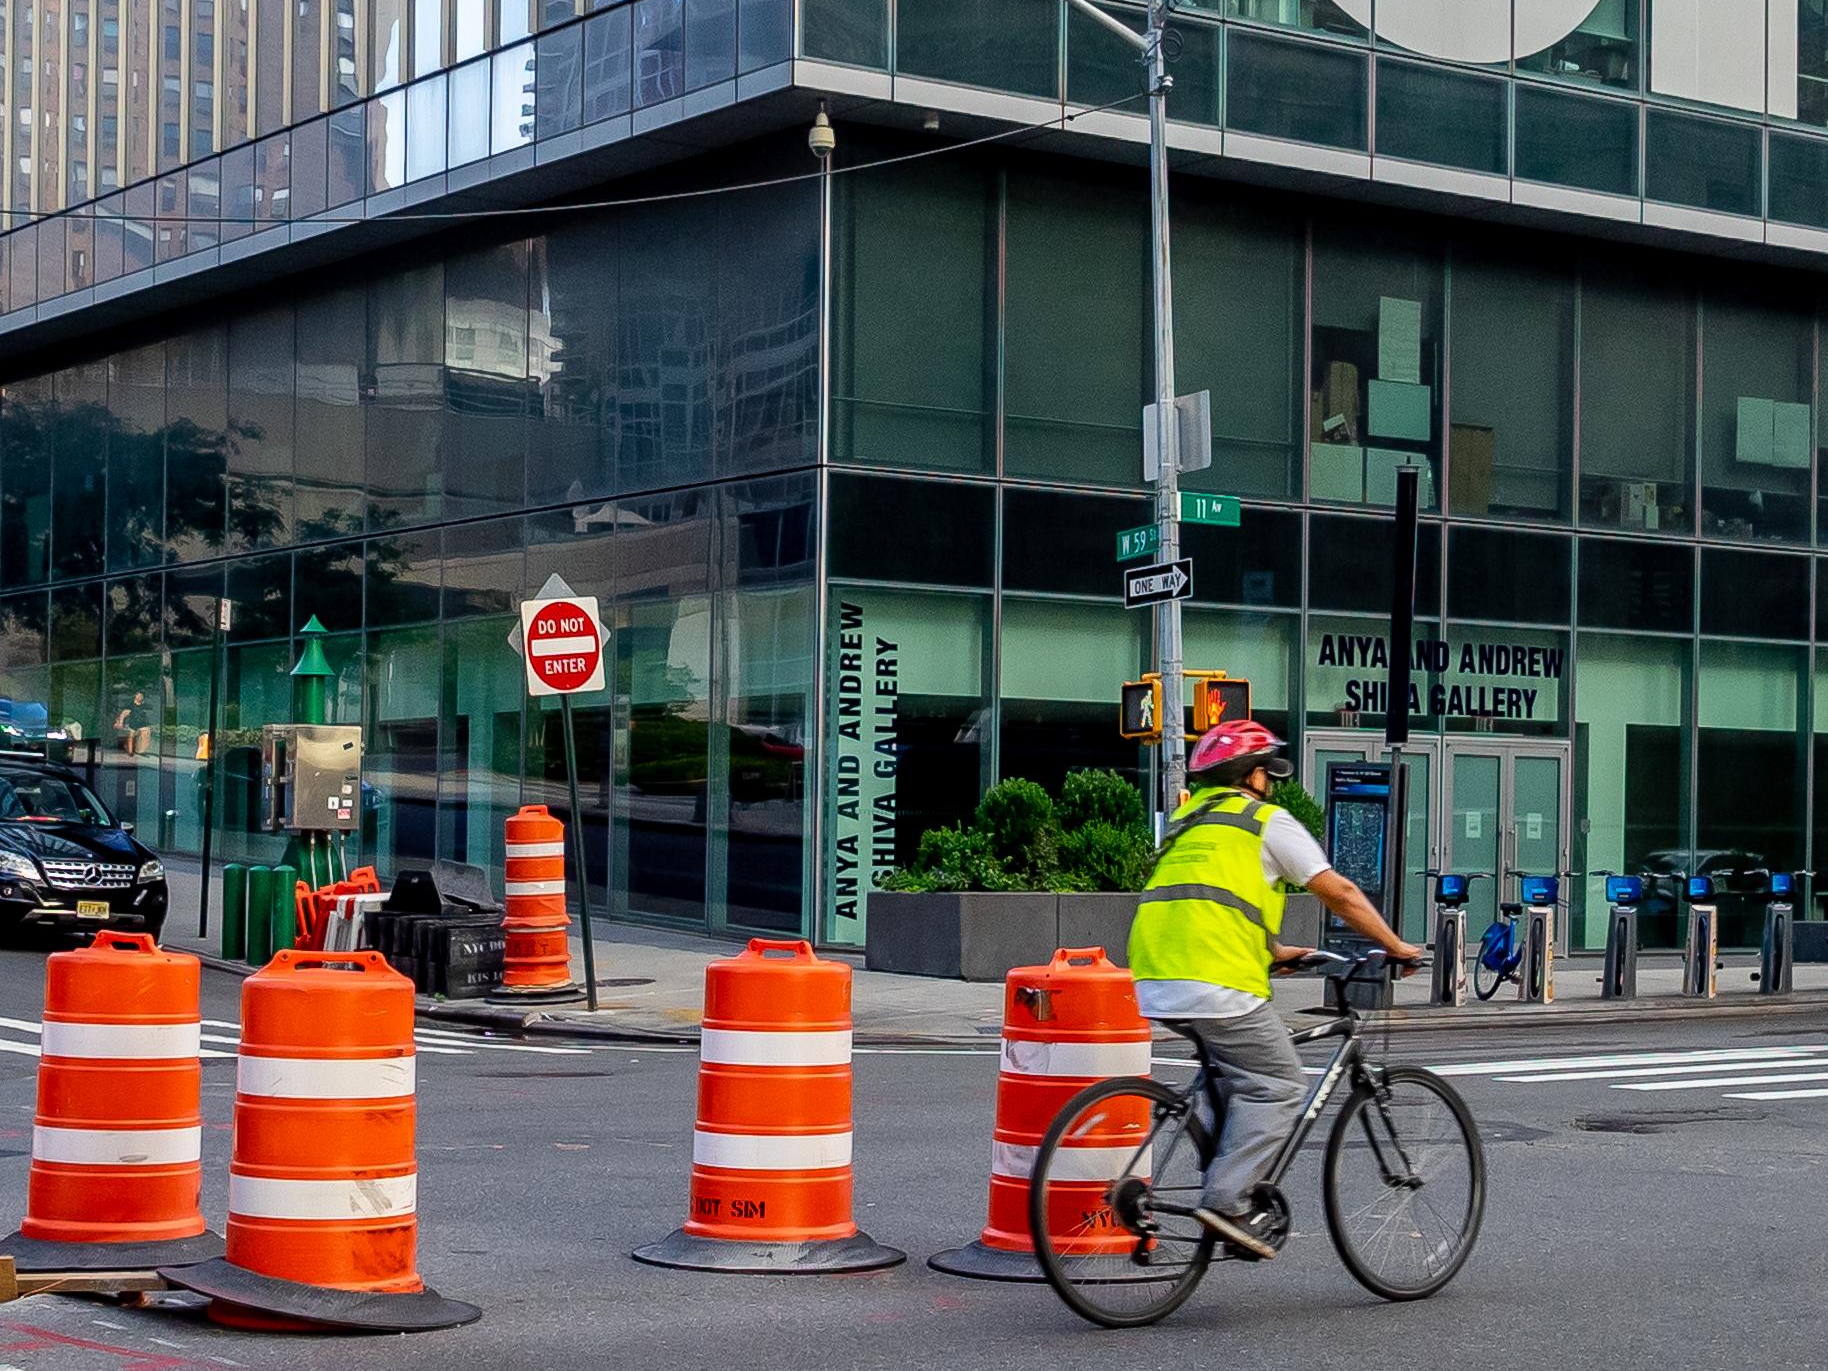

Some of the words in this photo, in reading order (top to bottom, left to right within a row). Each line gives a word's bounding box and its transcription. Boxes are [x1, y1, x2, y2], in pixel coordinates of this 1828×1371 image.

[1196, 498, 1207, 519] 11
[1122, 535, 1130, 556] W
[1134, 530, 1146, 554] 59
[1134, 578, 1154, 594] ONE
[1161, 573, 1182, 590] WAY
[537, 619, 557, 635] DO
[560, 617, 585, 634] NOT
[545, 658, 586, 675] ENTER
[839, 601, 864, 742] ANDREW
[1318, 634, 1389, 670] ANYA
[1458, 643, 1564, 679] ANDREW
[873, 636, 898, 779] GALLERY
[1345, 680, 1421, 715] SHIA
[1430, 683, 1538, 719] GALLERY
[838, 754, 861, 821] AND
[871, 792, 897, 889] SHIVA
[836, 832, 860, 921] ANYA
